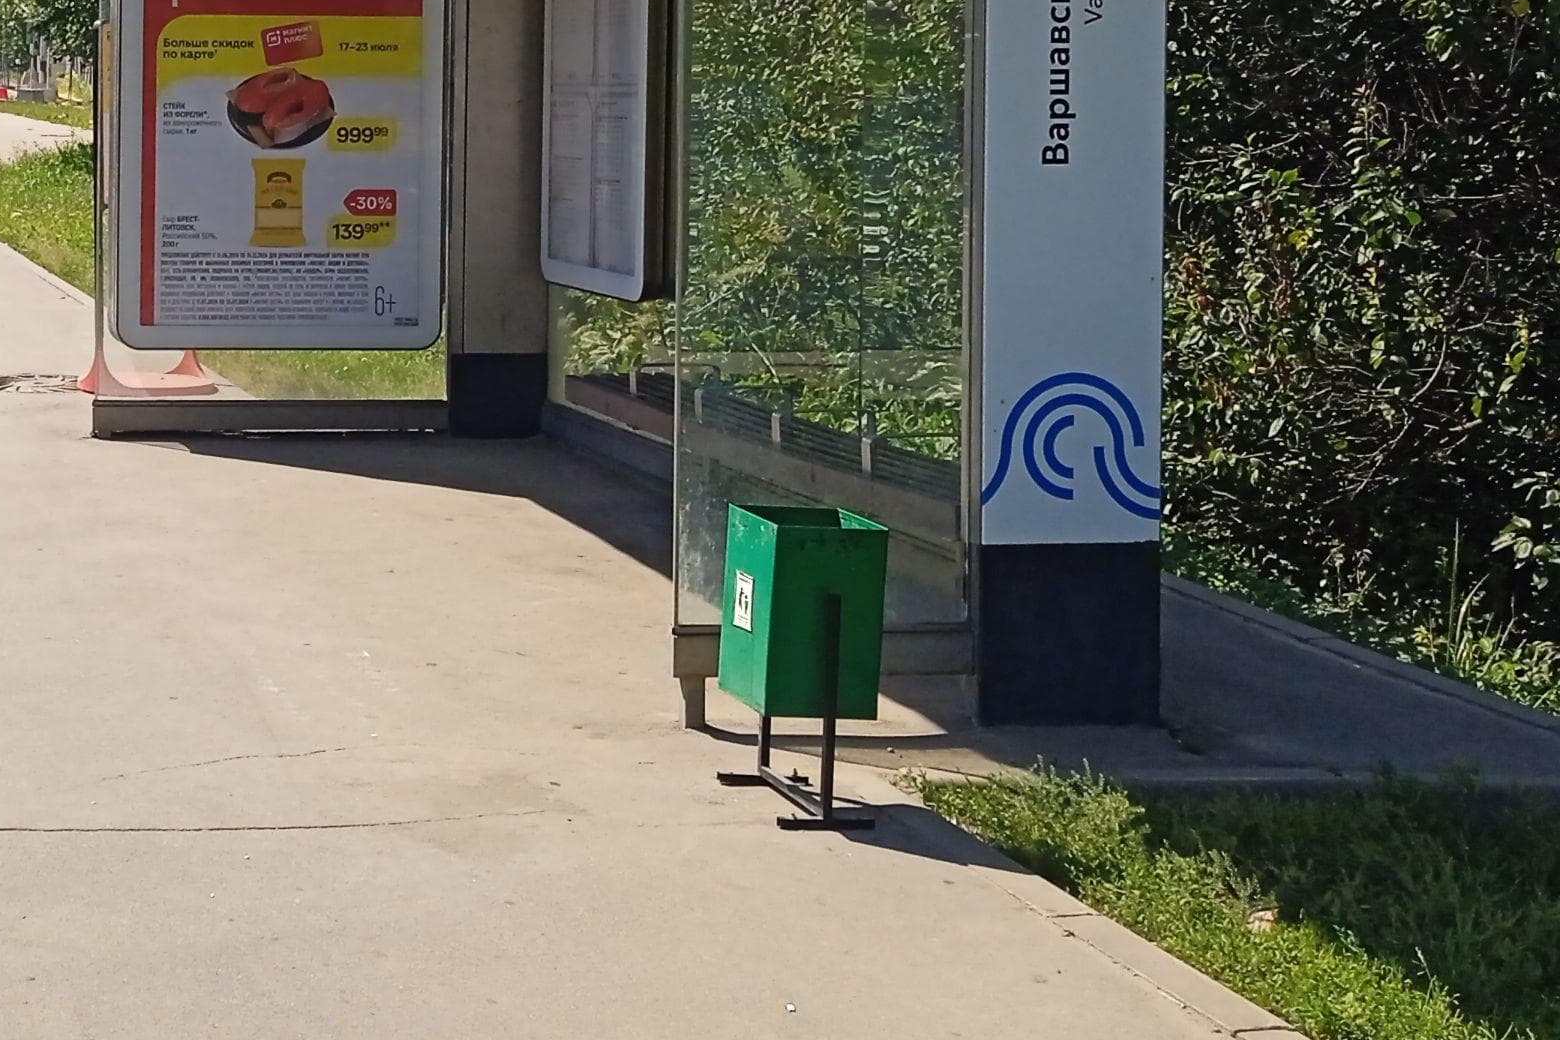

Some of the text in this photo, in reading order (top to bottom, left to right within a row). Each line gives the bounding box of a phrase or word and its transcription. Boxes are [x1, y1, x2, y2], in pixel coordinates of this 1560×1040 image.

[162, 38, 255, 49] Больше скидок
[370, 43, 399, 52] июля
[163, 51, 178, 59] по
[349, 195, 393, 210] -30%
[374, 285, 397, 316] 6+
